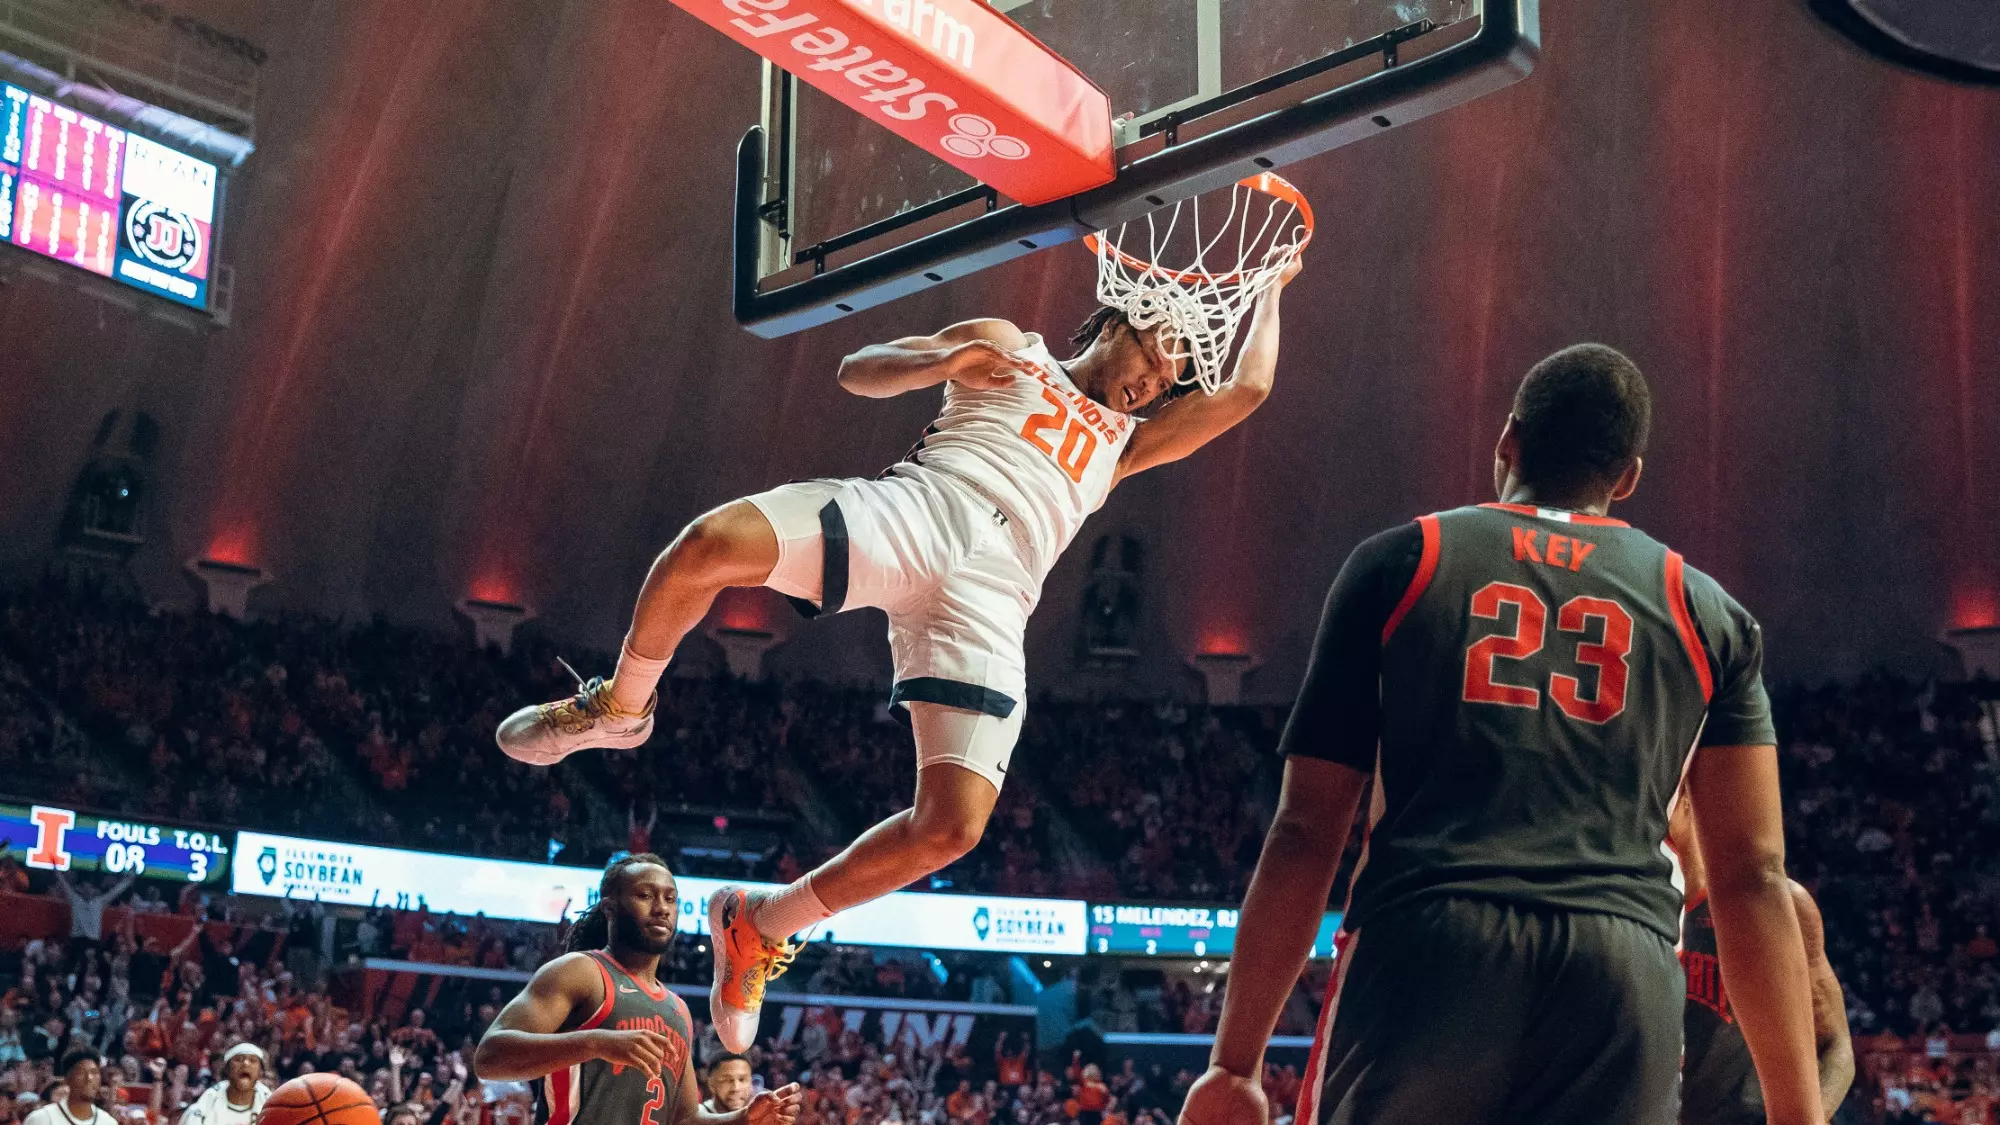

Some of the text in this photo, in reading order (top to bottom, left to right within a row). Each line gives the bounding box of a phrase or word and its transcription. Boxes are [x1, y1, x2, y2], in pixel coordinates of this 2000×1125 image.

[861, 0, 975, 69] arm
[1020, 387, 1097, 483] 20
[1511, 526, 1597, 573] KEY
[1462, 580, 1634, 725] 23
[97, 820, 160, 846] FOULS
[187, 852, 207, 882] 3
[284, 861, 363, 885] SOYBEAN
[1093, 905, 1114, 924] 15
[1145, 939, 1157, 955] 2
[639, 1076, 666, 1125] 2
